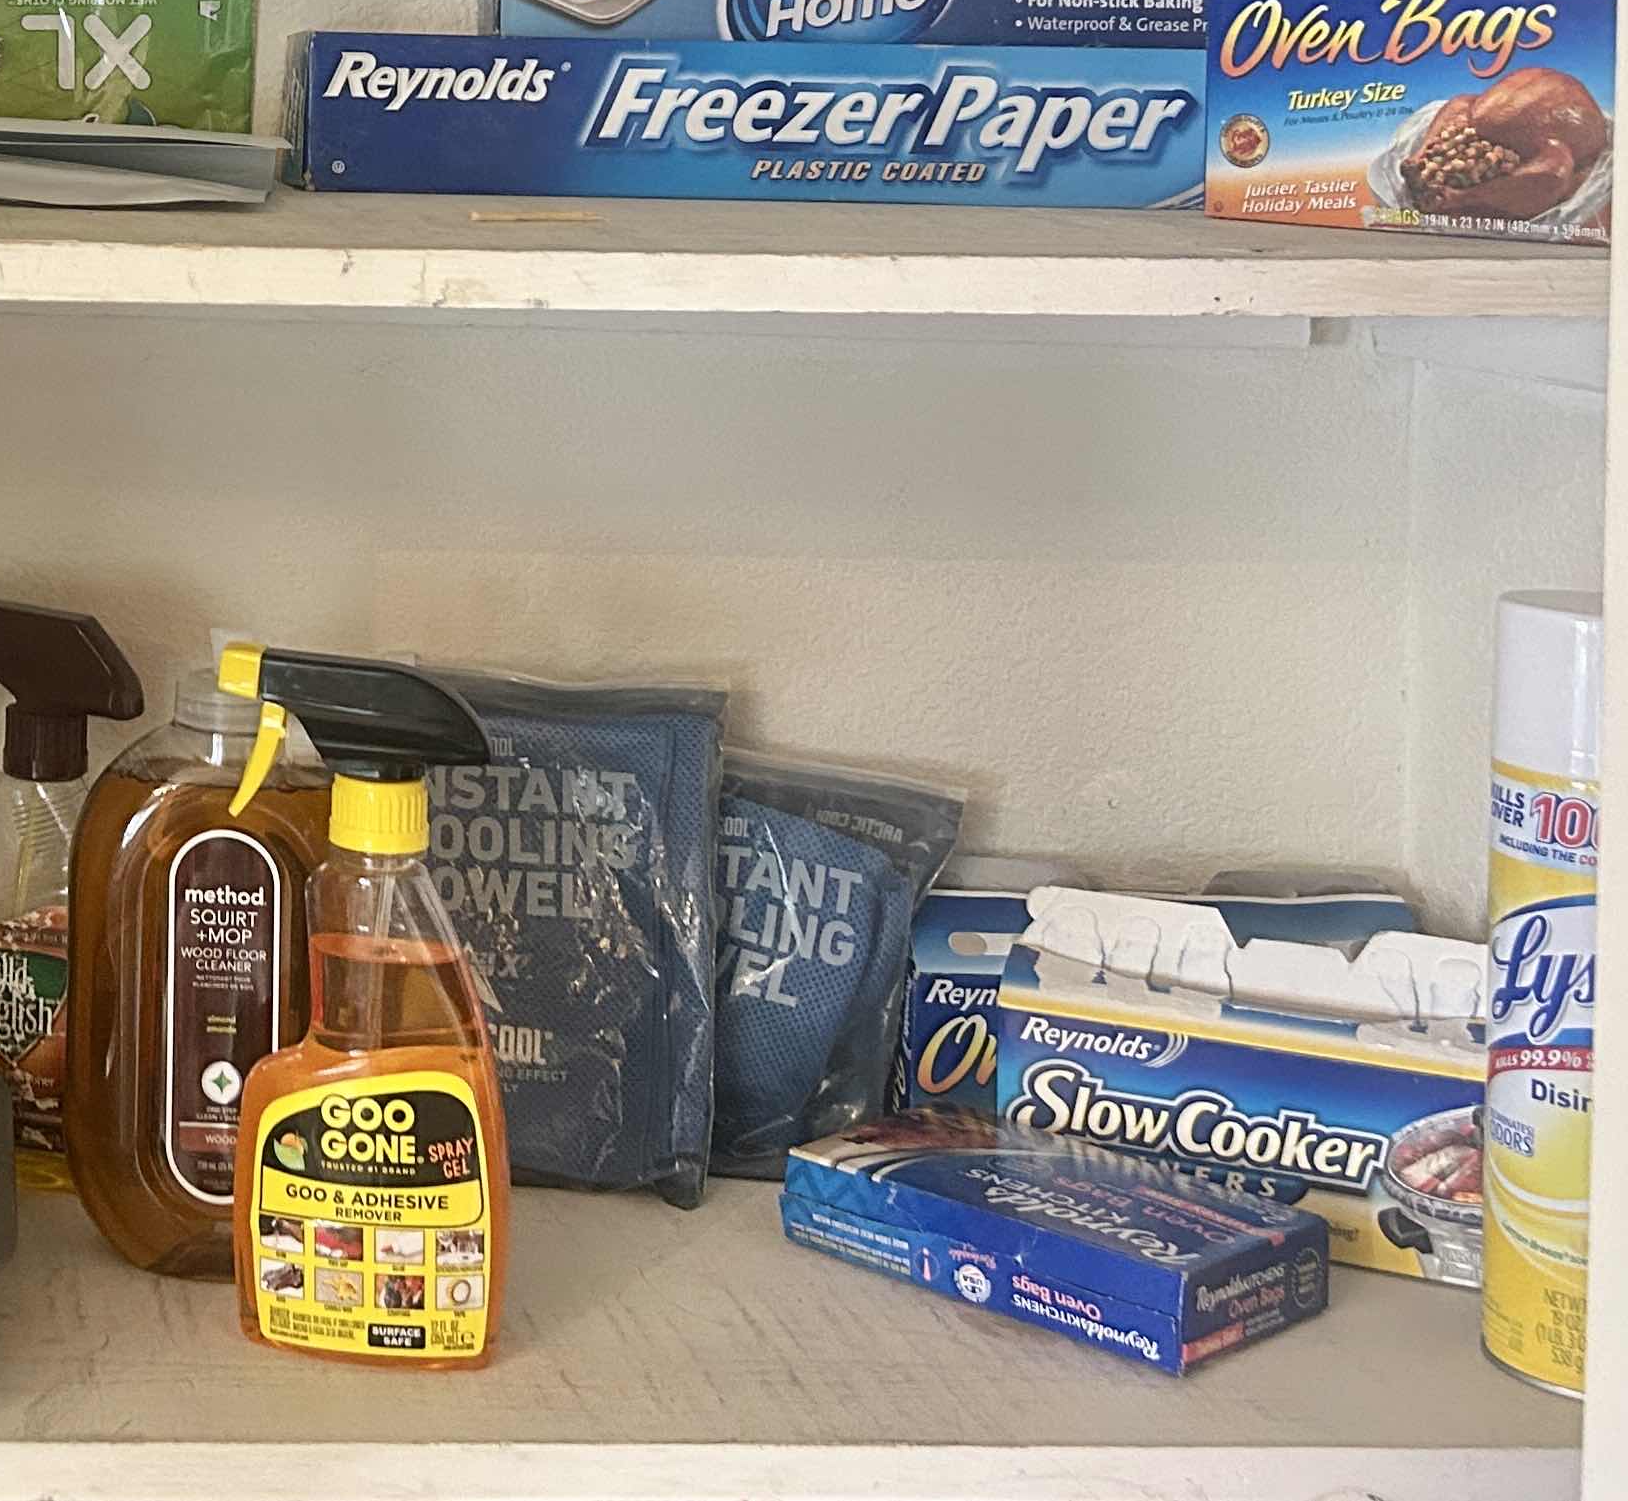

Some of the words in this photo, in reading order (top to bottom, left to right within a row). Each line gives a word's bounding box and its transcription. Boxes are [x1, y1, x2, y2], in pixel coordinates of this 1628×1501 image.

[1027, 17, 1114, 36] Waterproof
[1118, 18, 1132, 32] &
[1137, 18, 1189, 36] Grease
[21, 13, 153, 91] XL
[1287, 86, 1359, 113] Turkey
[1362, 81, 1406, 103] Size
[322, 51, 554, 110] Reynolds
[598, 67, 924, 147] Freezer
[923, 75, 1187, 173] Paper
[751, 159, 872, 180] PLASTIC
[882, 161, 987, 182] COATED
[1304, 179, 1357, 194] Tastier
[1242, 198, 1303, 215] Holiday
[1308, 195, 1357, 210] Meals
[425, 765, 636, 820] NSTANT
[431, 814, 637, 869] OOLING
[1552, 848, 1576, 863] THE
[185, 885, 264, 905] method
[435, 866, 594, 919] OWEL
[191, 908, 258, 927] SQUIRT
[181, 946, 222, 959] WOOD
[226, 948, 266, 961] FLOOR
[196, 960, 251, 972] CLEANER
[1020, 1016, 1152, 1061] Reynolds
[1520, 1049, 1582, 1068] 99.9%
[321, 1094, 415, 1132] GOO
[1017, 1069, 1169, 1144] Slow
[1176, 1102, 1376, 1178] Cooker
[427, 1137, 475, 1163] SPRAY
[322, 1161, 364, 1174] TRUSTED
[443, 1158, 470, 1180] GEL
[286, 1182, 327, 1203] GOO
[333, 1190, 345, 1205] &
[351, 1191, 449, 1211] ADHESIVE
[966, 1168, 1130, 1225] KITCHENS
[335, 1208, 402, 1223] REMOVER
[986, 1187, 1201, 1265] Reynolds
[1012, 1275, 1058, 1305] Bags
[1067, 1292, 1103, 1322] Oven
[372, 1325, 421, 1338] SURFACE
[384, 1335, 412, 1348] SAFE
